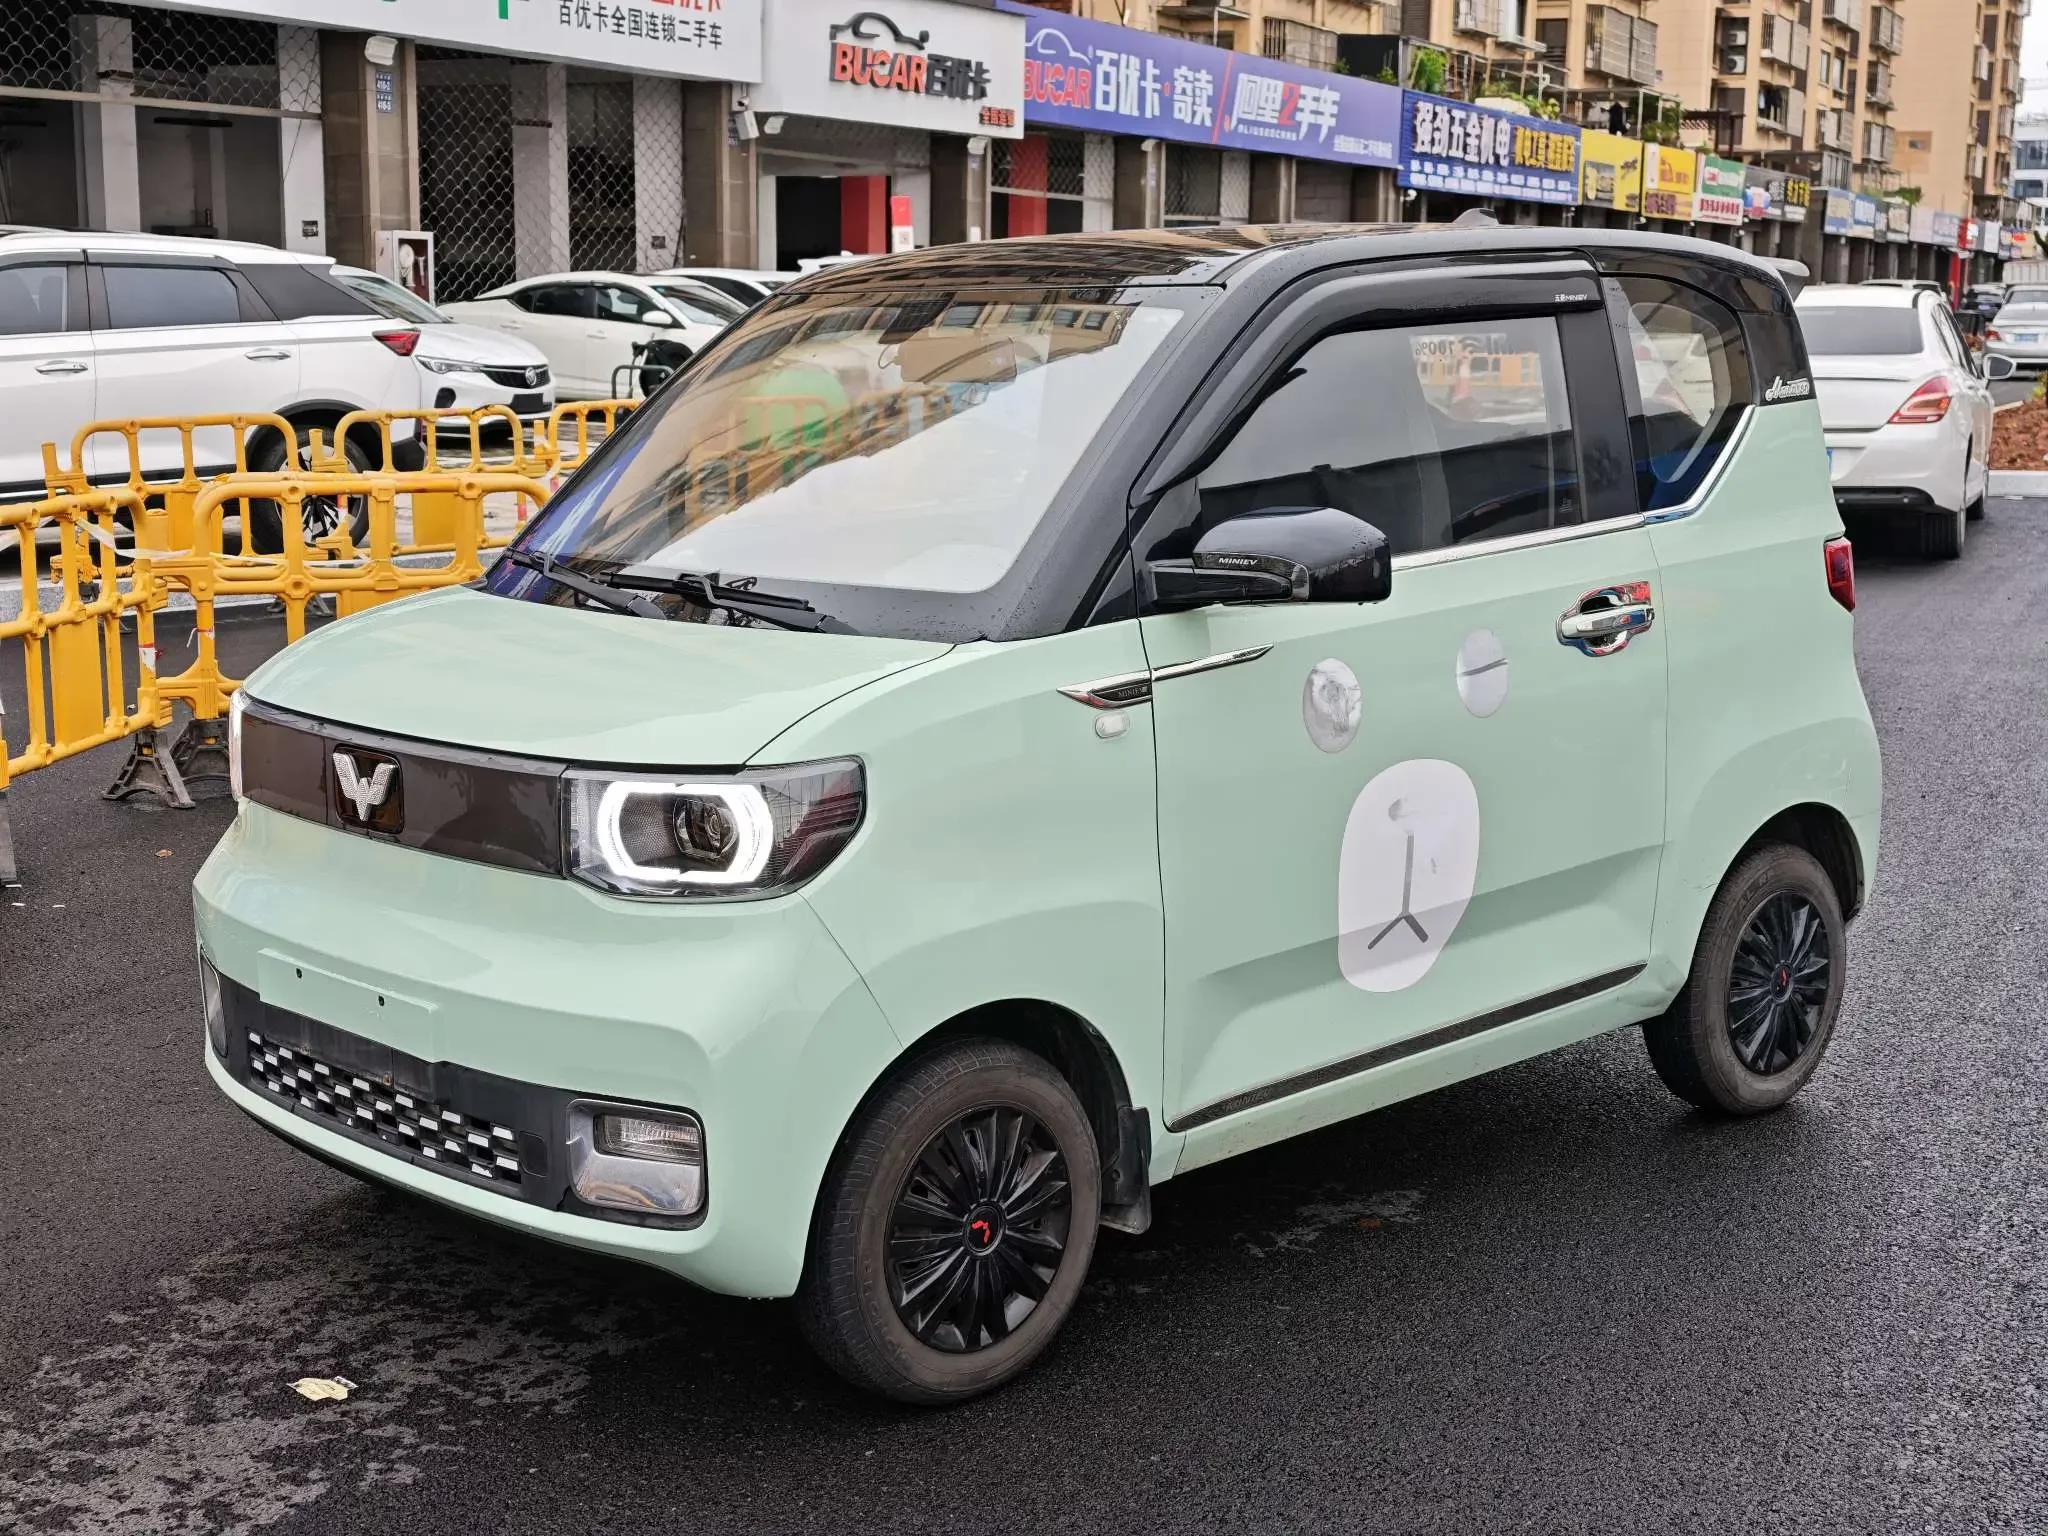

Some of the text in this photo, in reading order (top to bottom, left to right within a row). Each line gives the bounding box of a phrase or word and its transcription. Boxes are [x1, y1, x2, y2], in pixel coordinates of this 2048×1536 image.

[559, 0, 722, 49] 百优卡全国连锁二手车
[830, 42, 928, 94] BUCAR
[1218, 558, 1258, 566] MINIEV
